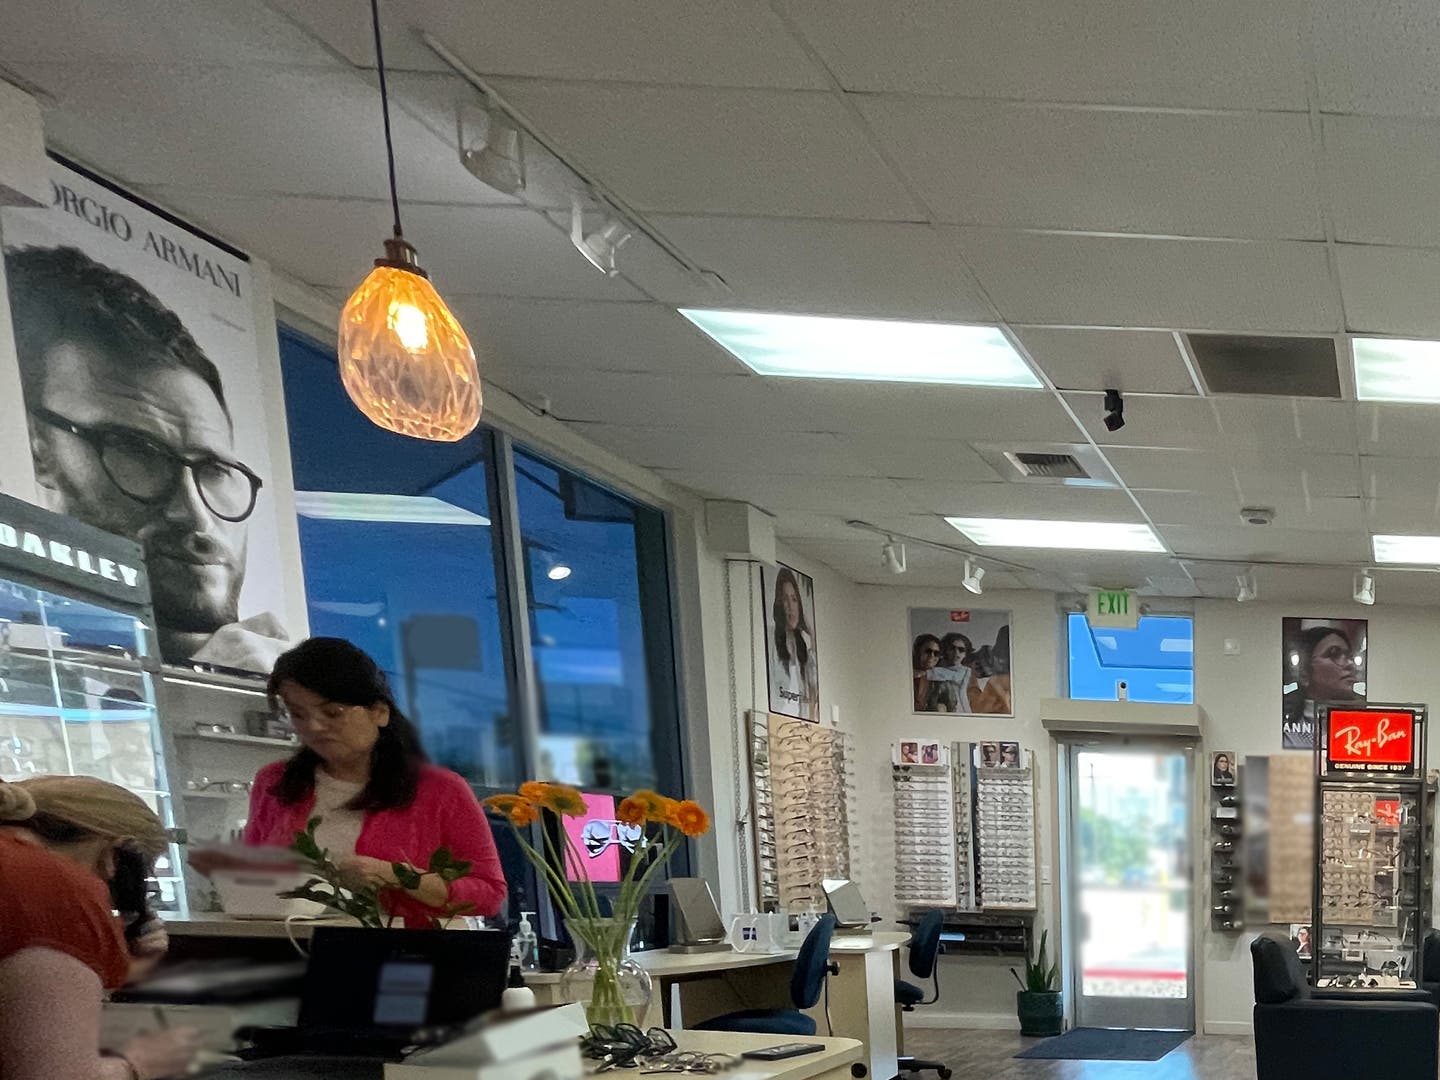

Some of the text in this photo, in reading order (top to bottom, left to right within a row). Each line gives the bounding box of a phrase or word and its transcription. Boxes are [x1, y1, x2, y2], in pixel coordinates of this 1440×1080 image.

[143, 231, 241, 298] ARMANI
[1097, 592, 1129, 615] EXIT
[1335, 718, 1407, 756] Ray-Ban
